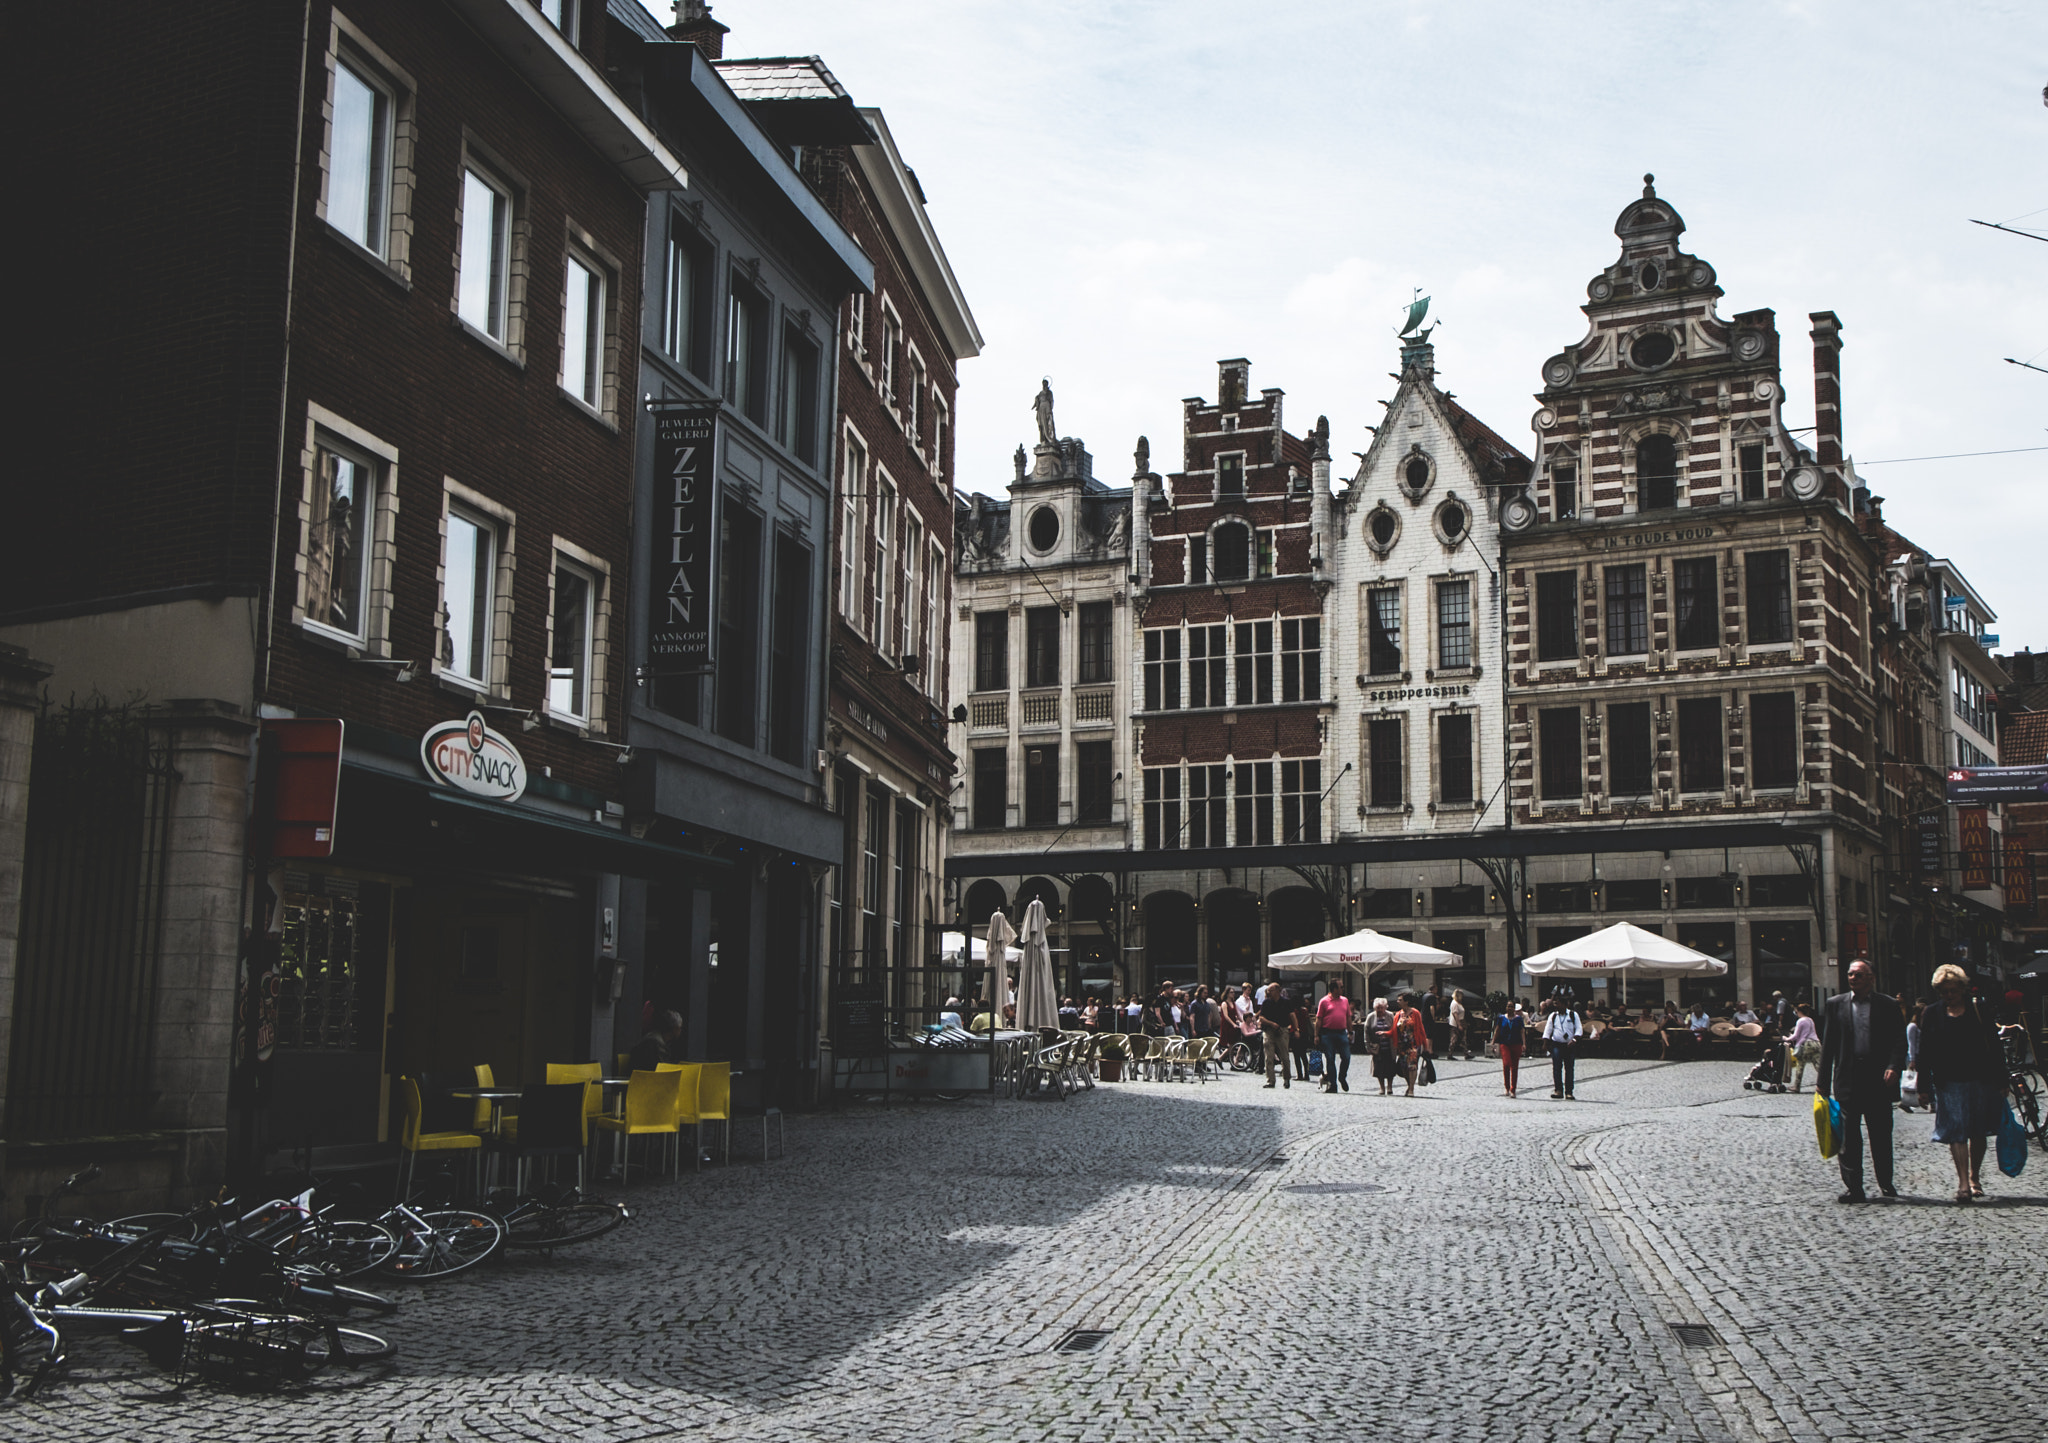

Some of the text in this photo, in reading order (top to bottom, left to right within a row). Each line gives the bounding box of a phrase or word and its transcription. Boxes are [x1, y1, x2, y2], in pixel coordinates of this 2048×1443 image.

[659, 418, 713, 429] JUWELEN
[661, 429, 710, 440] GALERIJ
[666, 446, 697, 624] ZELLAN
[1634, 531, 1672, 545] OUDE
[1675, 527, 1713, 540] WOUD
[653, 631, 707, 643] AANKOOP
[652, 643, 706, 654] VERKOOP
[437, 744, 517, 790] CITY SNACK
[1340, 953, 1363, 962] Duvel
[1583, 959, 1606, 968] Duvel
